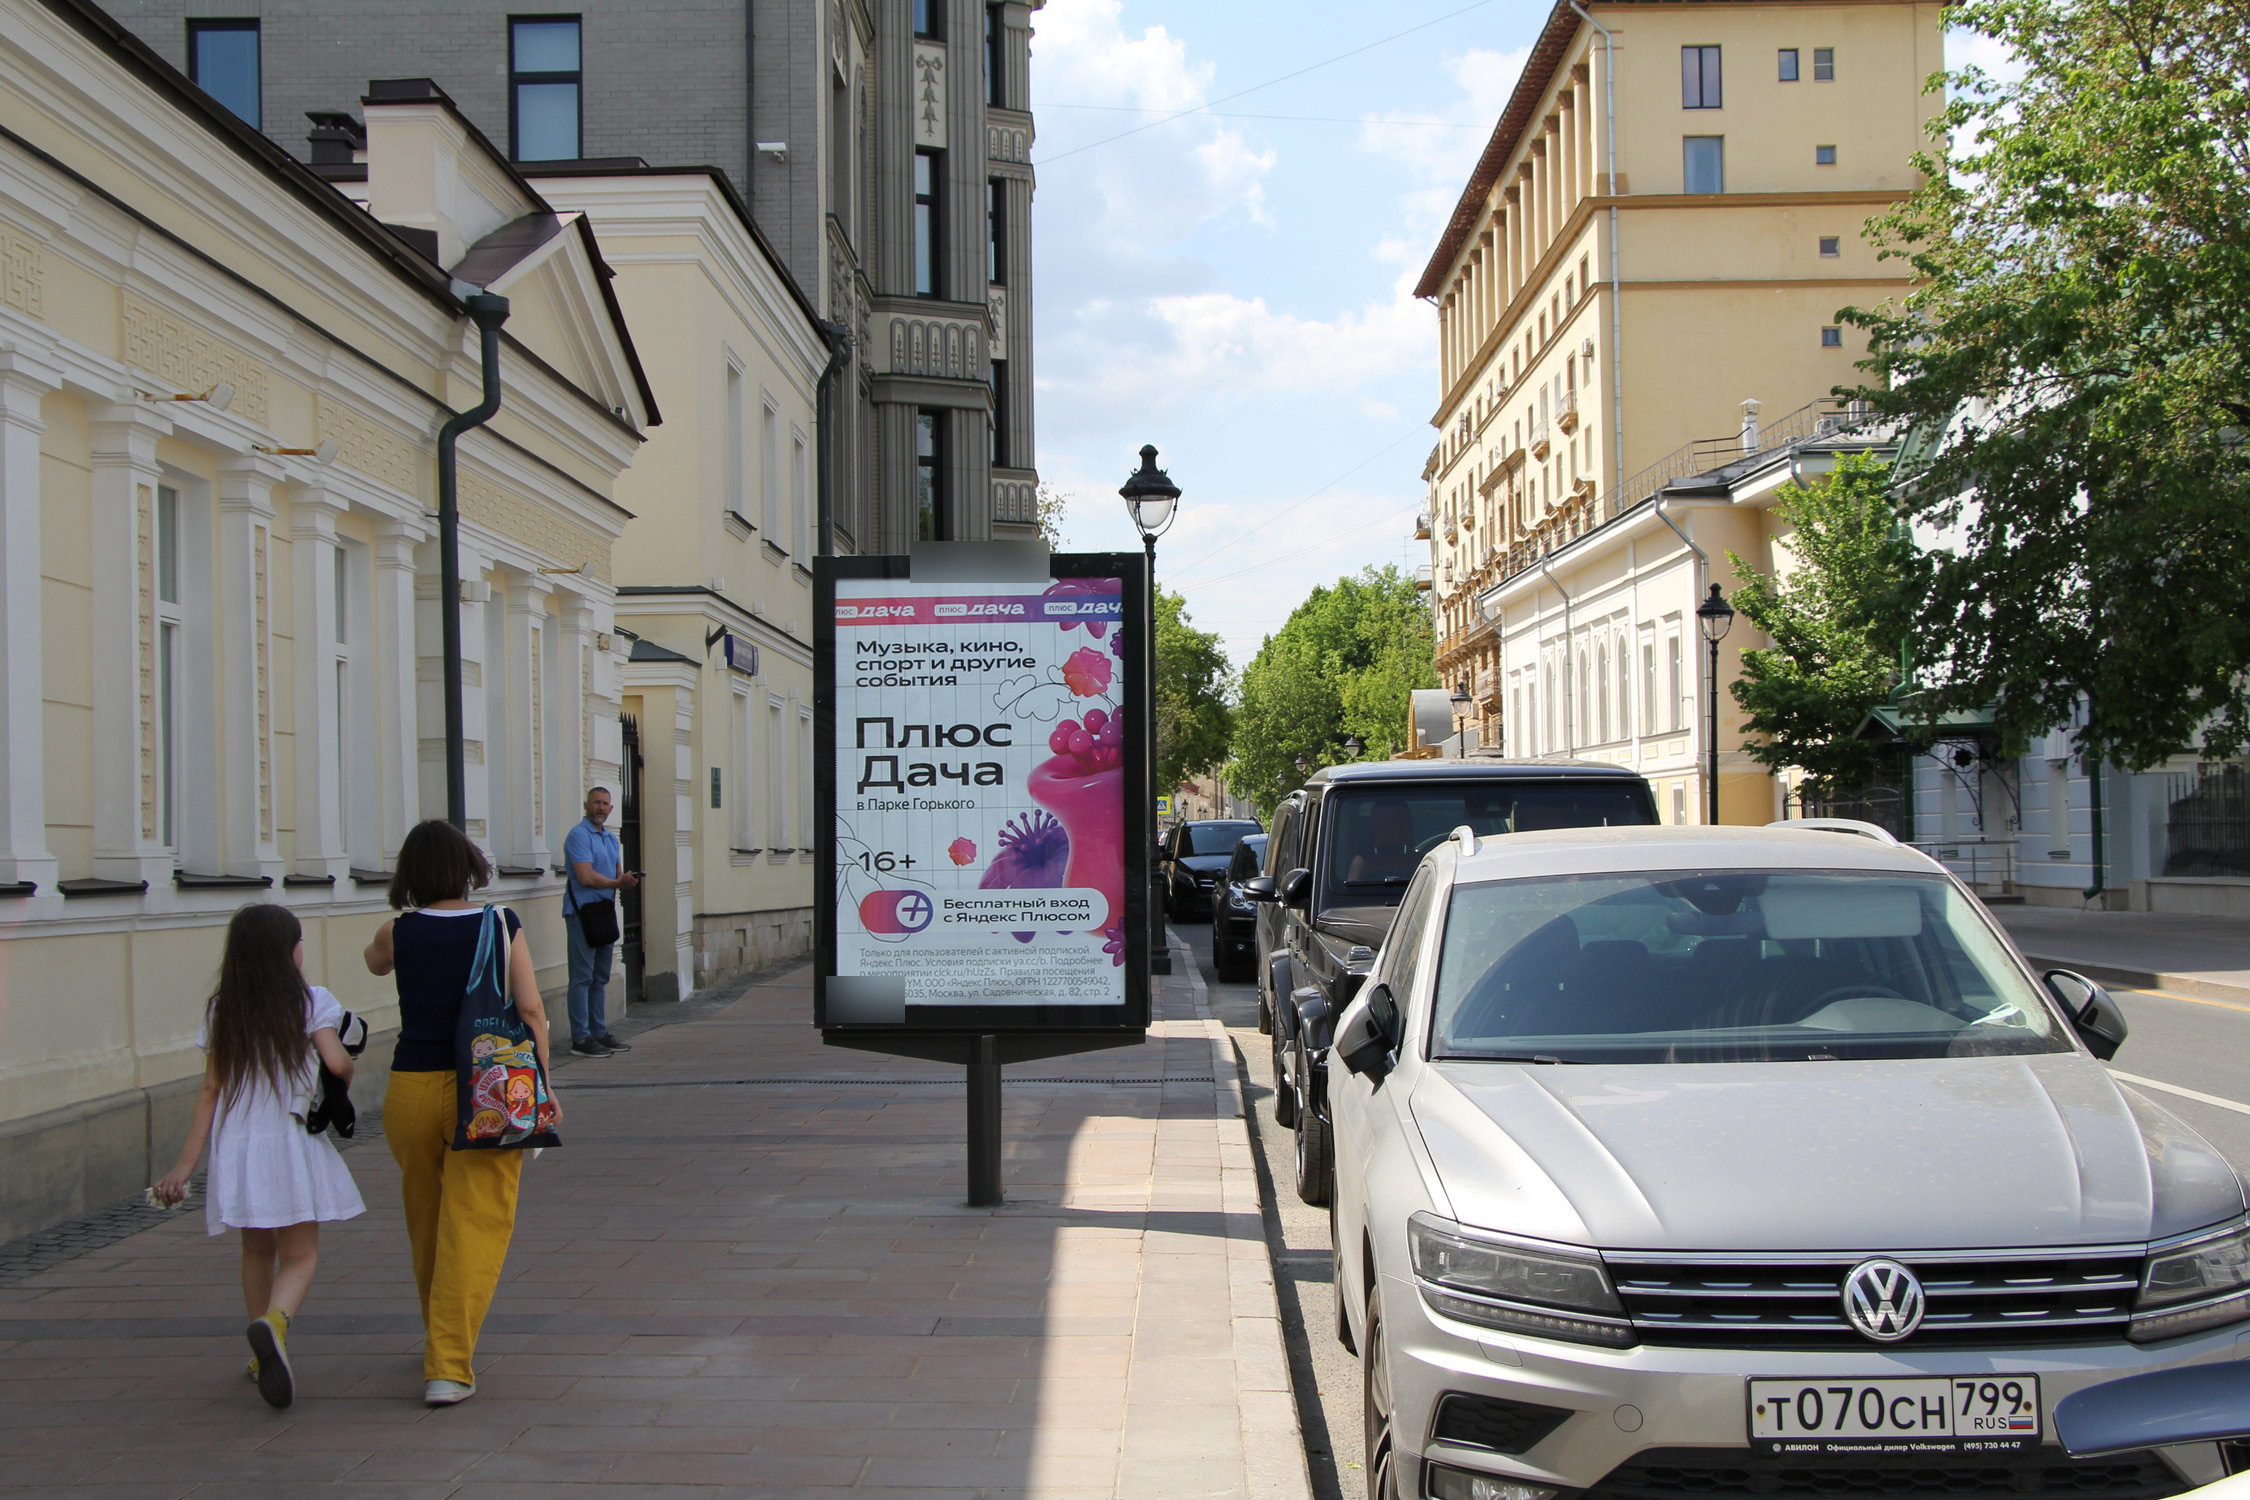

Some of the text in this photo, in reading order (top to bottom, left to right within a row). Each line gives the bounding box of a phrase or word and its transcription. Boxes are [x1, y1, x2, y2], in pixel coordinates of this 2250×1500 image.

[835, 601, 1124, 618] люс дача плюс дача плюс дач
[856, 640, 1024, 655] Музыка, кино,
[856, 656, 1036, 674] спорт и другие
[856, 674, 958, 688] события
[856, 716, 1012, 748] Плюс
[857, 755, 1004, 794] Дача
[856, 798, 975, 812] в Парке Горького
[858, 851, 916, 872] 16+
[944, 897, 1090, 910] Бесплатный вход
[944, 912, 1091, 924] с Яндекс Плюсом
[860, 948, 895, 957] Только
[897, 950, 911, 958] для
[913, 947, 984, 956] пользователей
[992, 947, 1037, 956] активной
[1039, 946, 1090, 956] подпиской
[860, 958, 893, 968] Яндекс
[896, 958, 924, 966] Плюс.
[925, 958, 963, 966] Условия
[966, 958, 1012, 967] подписки
[1050, 956, 1103, 966] Подробнее
[1000, 968, 1033, 978] Правила
[1035, 968, 1095, 977] посещения
[925, 979, 945, 987] ООО
[1015, 978, 1040, 986] ОГРН
[928, 989, 966, 999] Москва,
[983, 988, 1056, 999] Садовническая,
[1058, 990, 1067, 998] д.
[1069, 988, 1082, 997] 82,
[1084, 989, 1102, 998] стр.
[1104, 988, 1110, 996] 2
[1845, 1260, 1921, 1339] VW
[1956, 1382, 2024, 1416] 799
[1974, 1417, 2007, 1430] RUS
[1784, 1444, 1819, 1452] АВИЛОН
[1826, 1443, 1882, 1452] Официальный
[1910, 1442, 1956, 1452] Volkswagen
[1963, 1442, 1982, 1450] (495)
[1984, 1442, 1998, 1450] 730
[2012, 1441, 2020, 1449] 47
